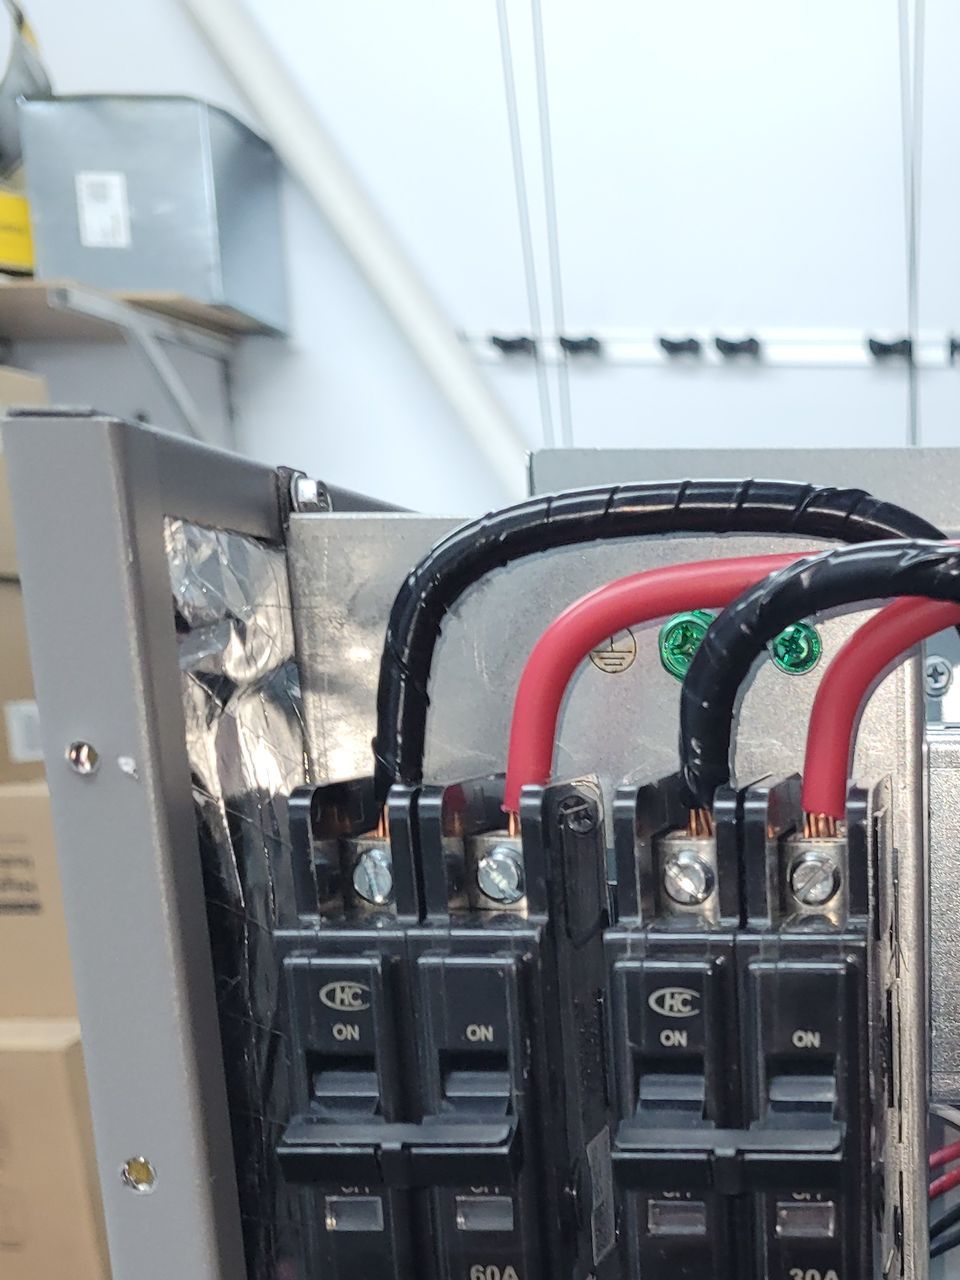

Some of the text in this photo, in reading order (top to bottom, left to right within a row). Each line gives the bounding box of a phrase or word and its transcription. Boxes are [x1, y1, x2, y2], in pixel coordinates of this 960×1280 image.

[332, 1022, 360, 1041] ON
[465, 1024, 494, 1042] ON
[659, 1029, 688, 1048] ON
[792, 1029, 821, 1049] ON
